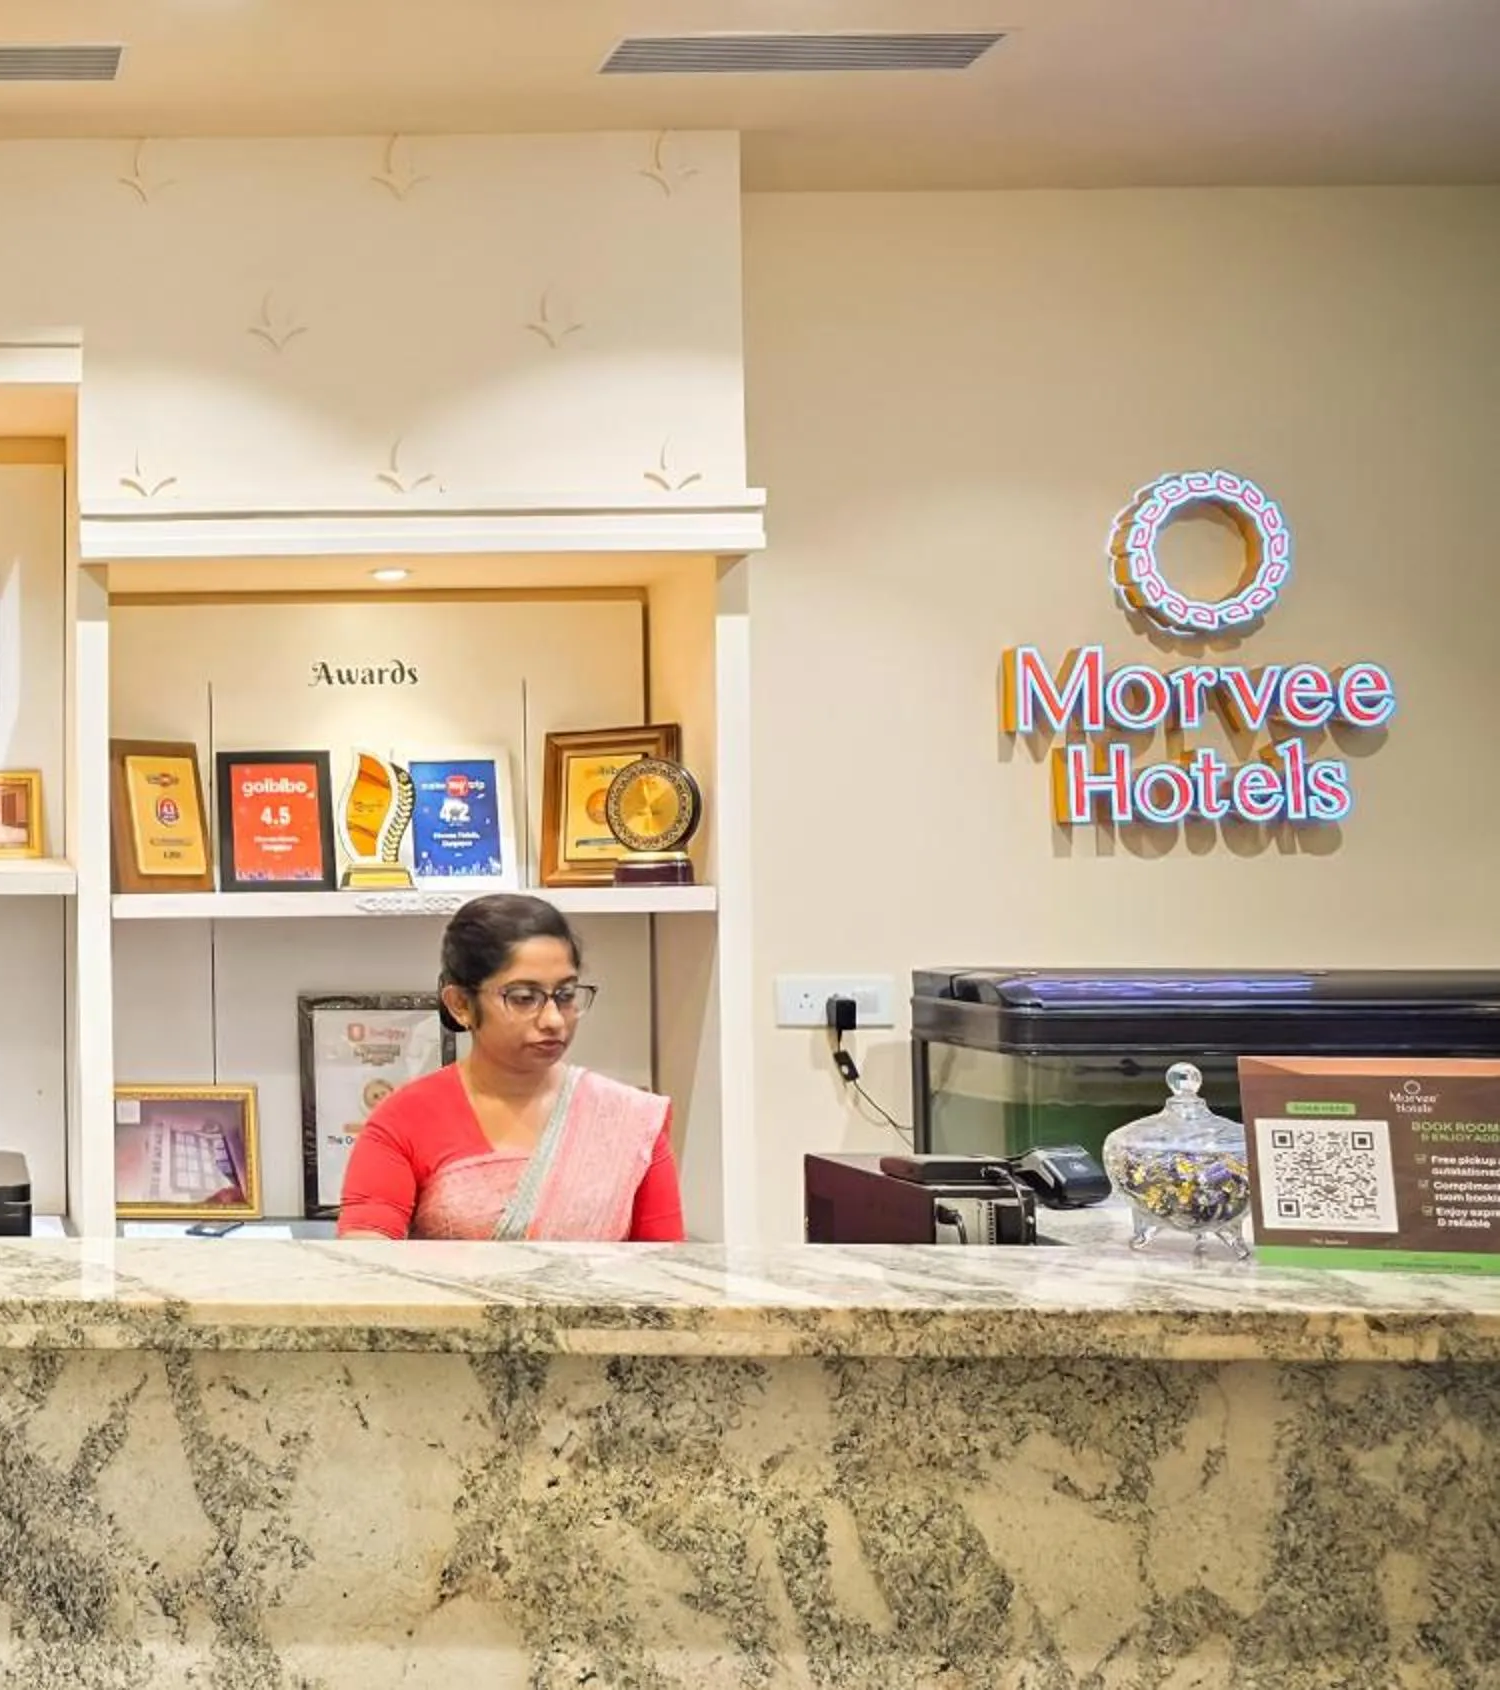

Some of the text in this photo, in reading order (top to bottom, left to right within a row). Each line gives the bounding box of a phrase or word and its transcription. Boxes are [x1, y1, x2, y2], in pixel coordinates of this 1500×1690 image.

[307, 659, 419, 687] Awards
[1014, 645, 1394, 731] Morvee
[242, 777, 308, 798] goibibo
[1065, 738, 1352, 823] Hotels
[261, 806, 291, 825] 4.5
[1411, 1121, 1453, 1131] BOOK
[1431, 1133, 1473, 1142] ENJOY
[1431, 1155, 1496, 1166] Free pickup
[1436, 1207, 1468, 1218] Enjoy
[1448, 1218, 1491, 1228] reliable
